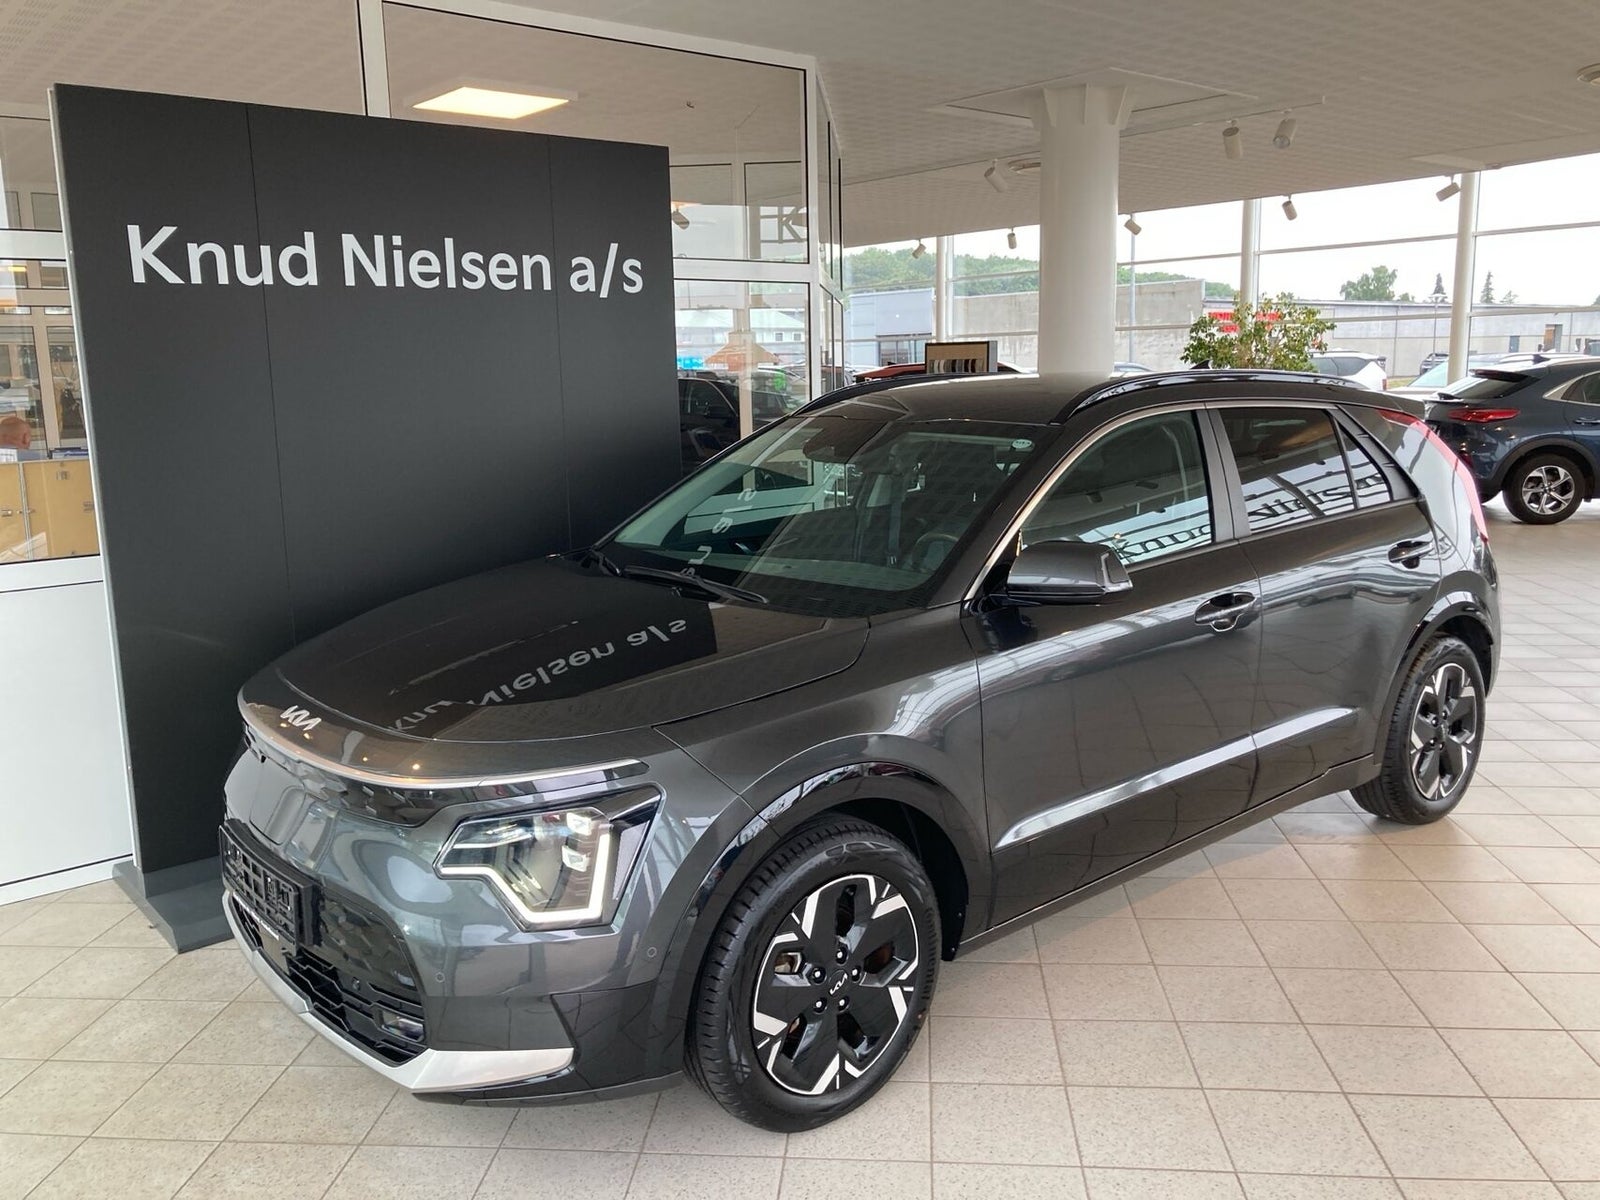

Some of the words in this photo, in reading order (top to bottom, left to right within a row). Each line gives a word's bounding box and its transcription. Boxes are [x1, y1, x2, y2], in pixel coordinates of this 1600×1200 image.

[127, 225, 318, 286] Knud
[342, 233, 552, 291] Nielsen
[569, 242, 644, 299] a/s
